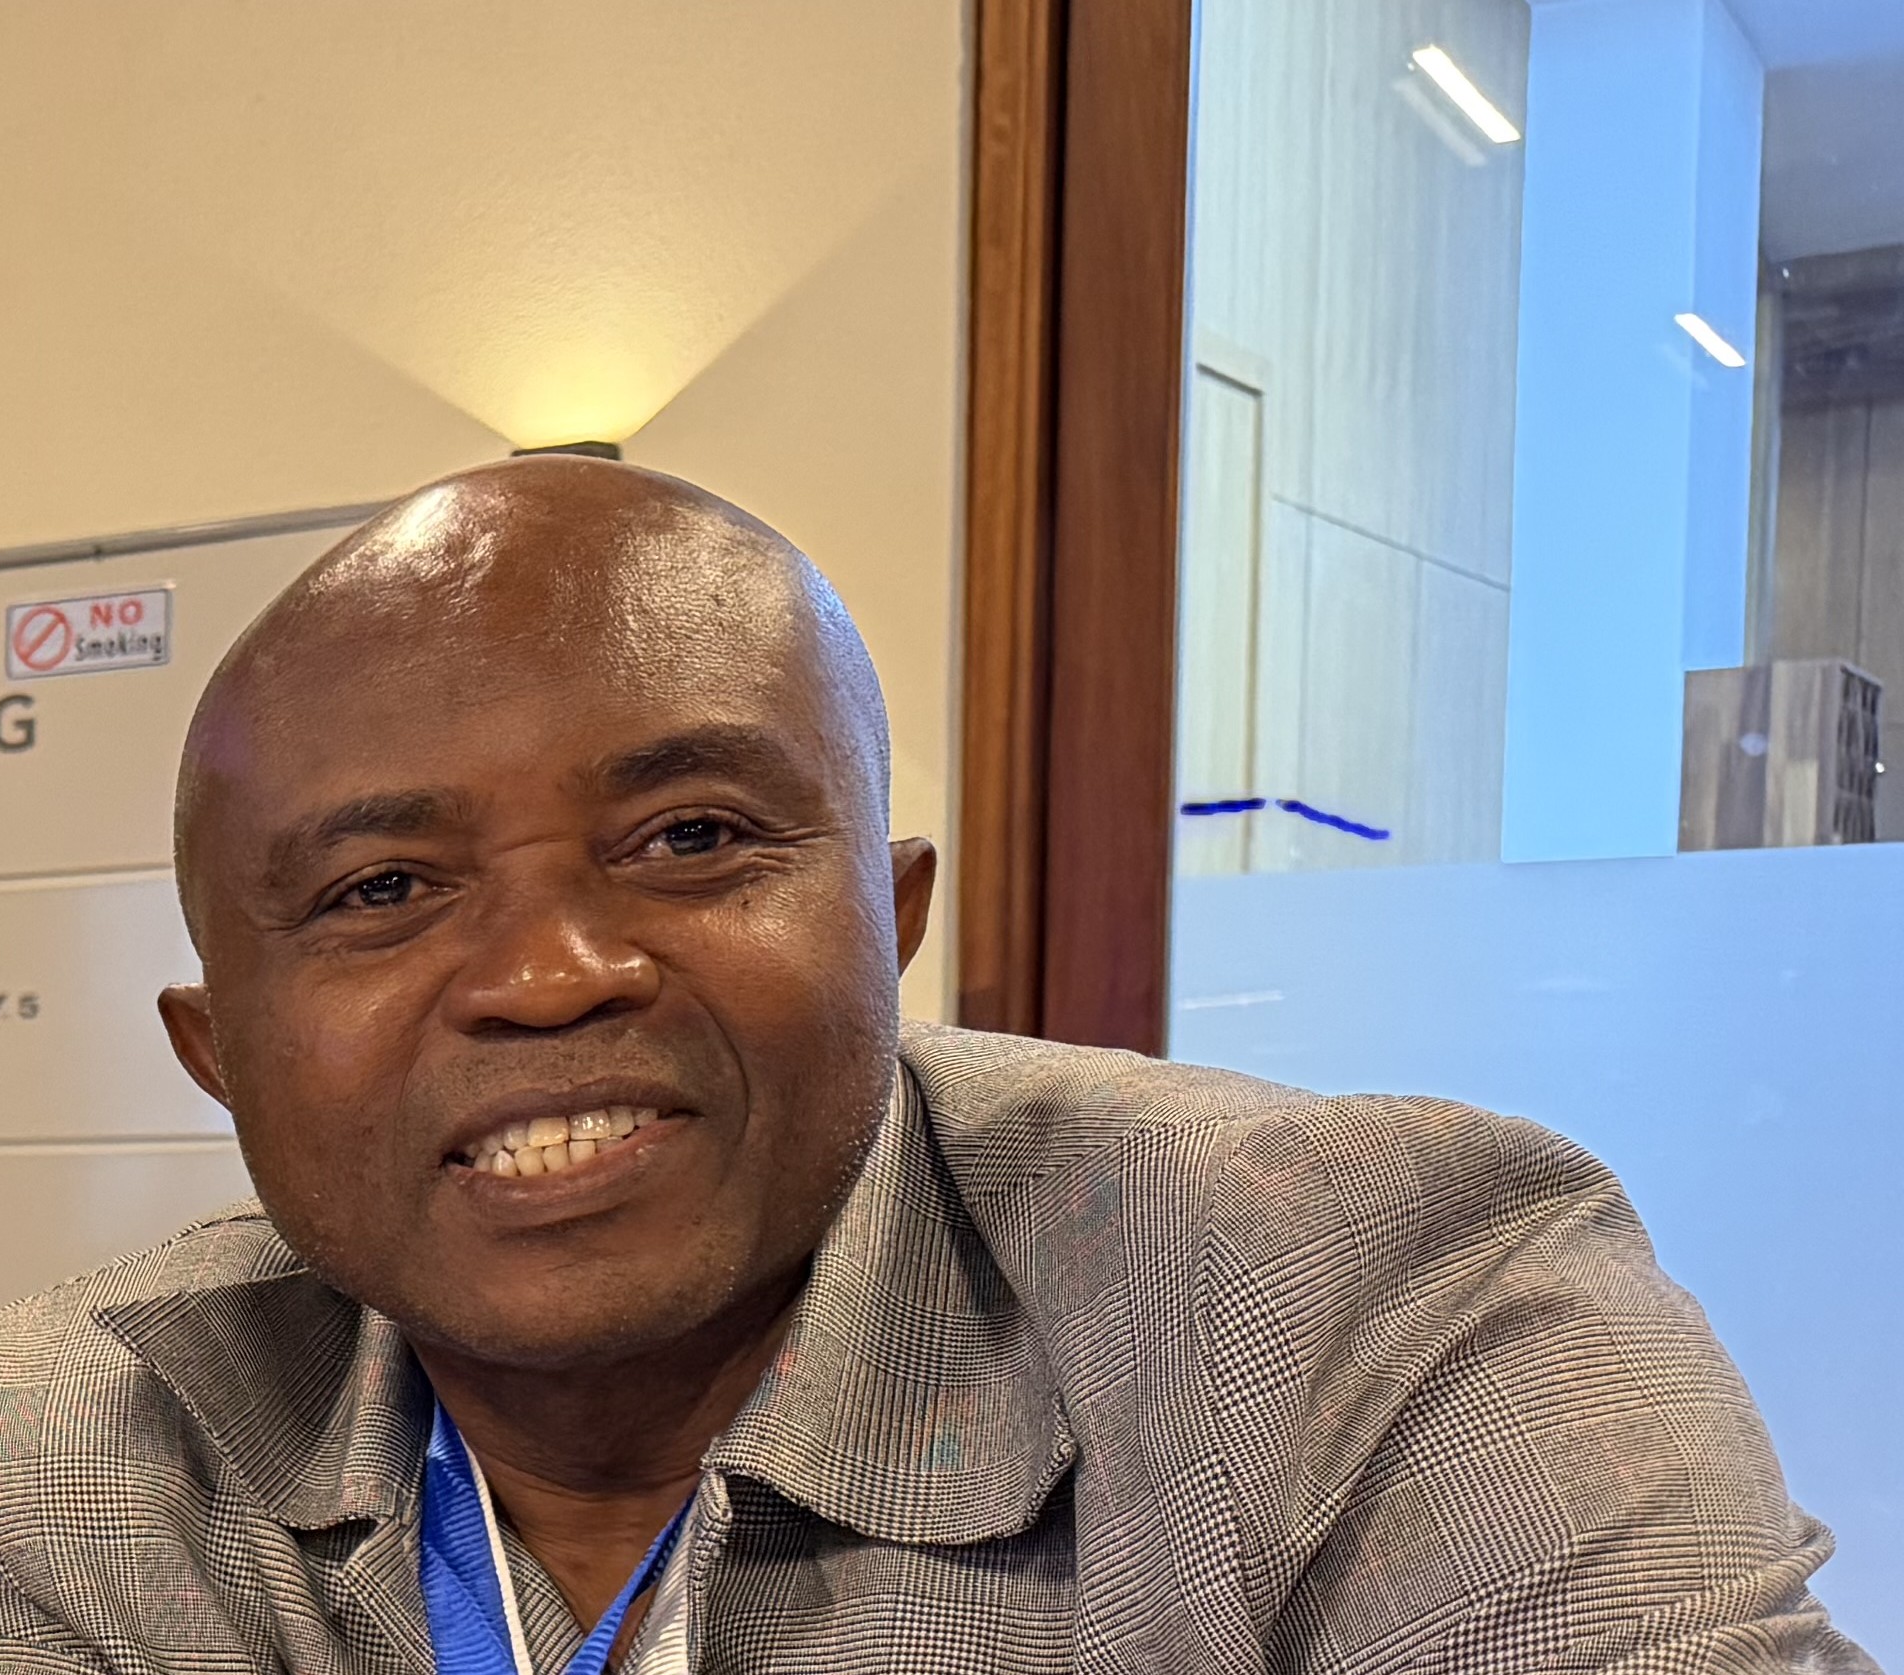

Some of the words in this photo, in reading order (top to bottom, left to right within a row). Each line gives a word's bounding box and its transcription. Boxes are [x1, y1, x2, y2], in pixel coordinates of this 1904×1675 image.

[90, 600, 145, 628] NO
[74, 631, 163, 662] Smoking
[19, 993, 41, 1020] 5
